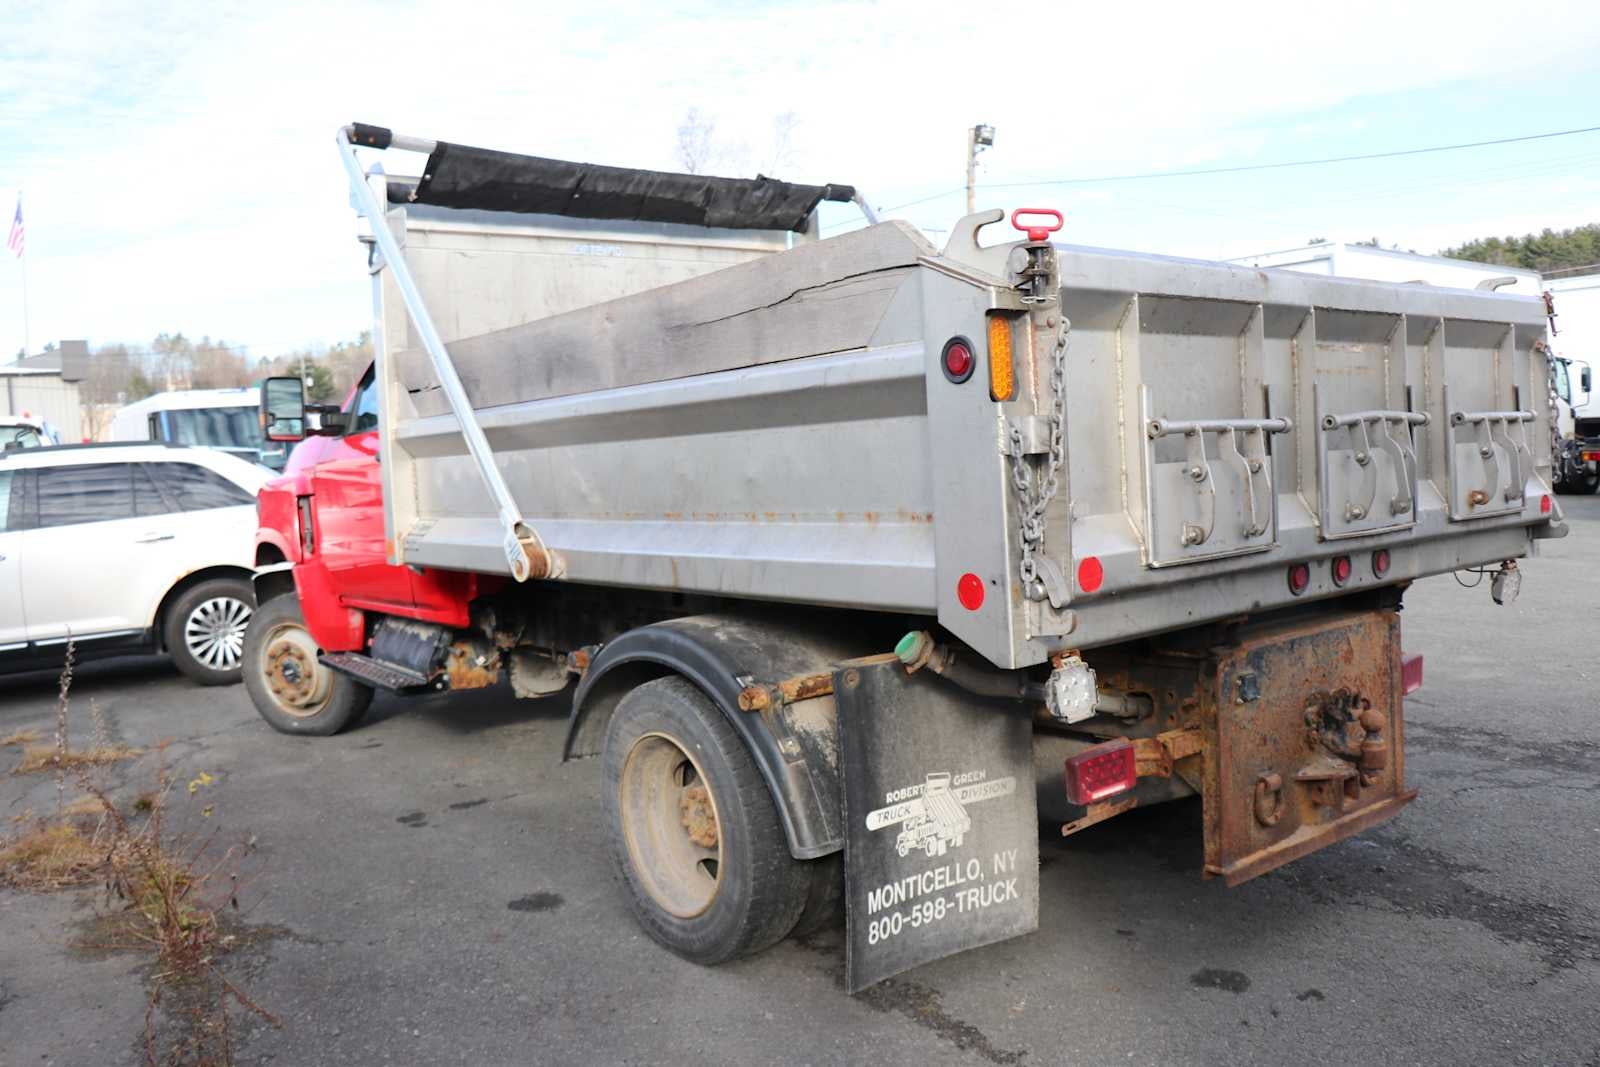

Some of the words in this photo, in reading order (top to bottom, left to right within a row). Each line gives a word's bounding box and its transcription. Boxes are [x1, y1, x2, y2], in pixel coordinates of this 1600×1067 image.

[877, 805, 911, 823] TRUCK
[961, 782, 1008, 800] DIVISION
[886, 784, 925, 803] ROBERT
[954, 769, 986, 785] GREEN
[868, 858, 984, 915] MONTICELLO,
[994, 849, 1018, 874] NY
[868, 878, 1018, 945] 800-598-TRUCK
